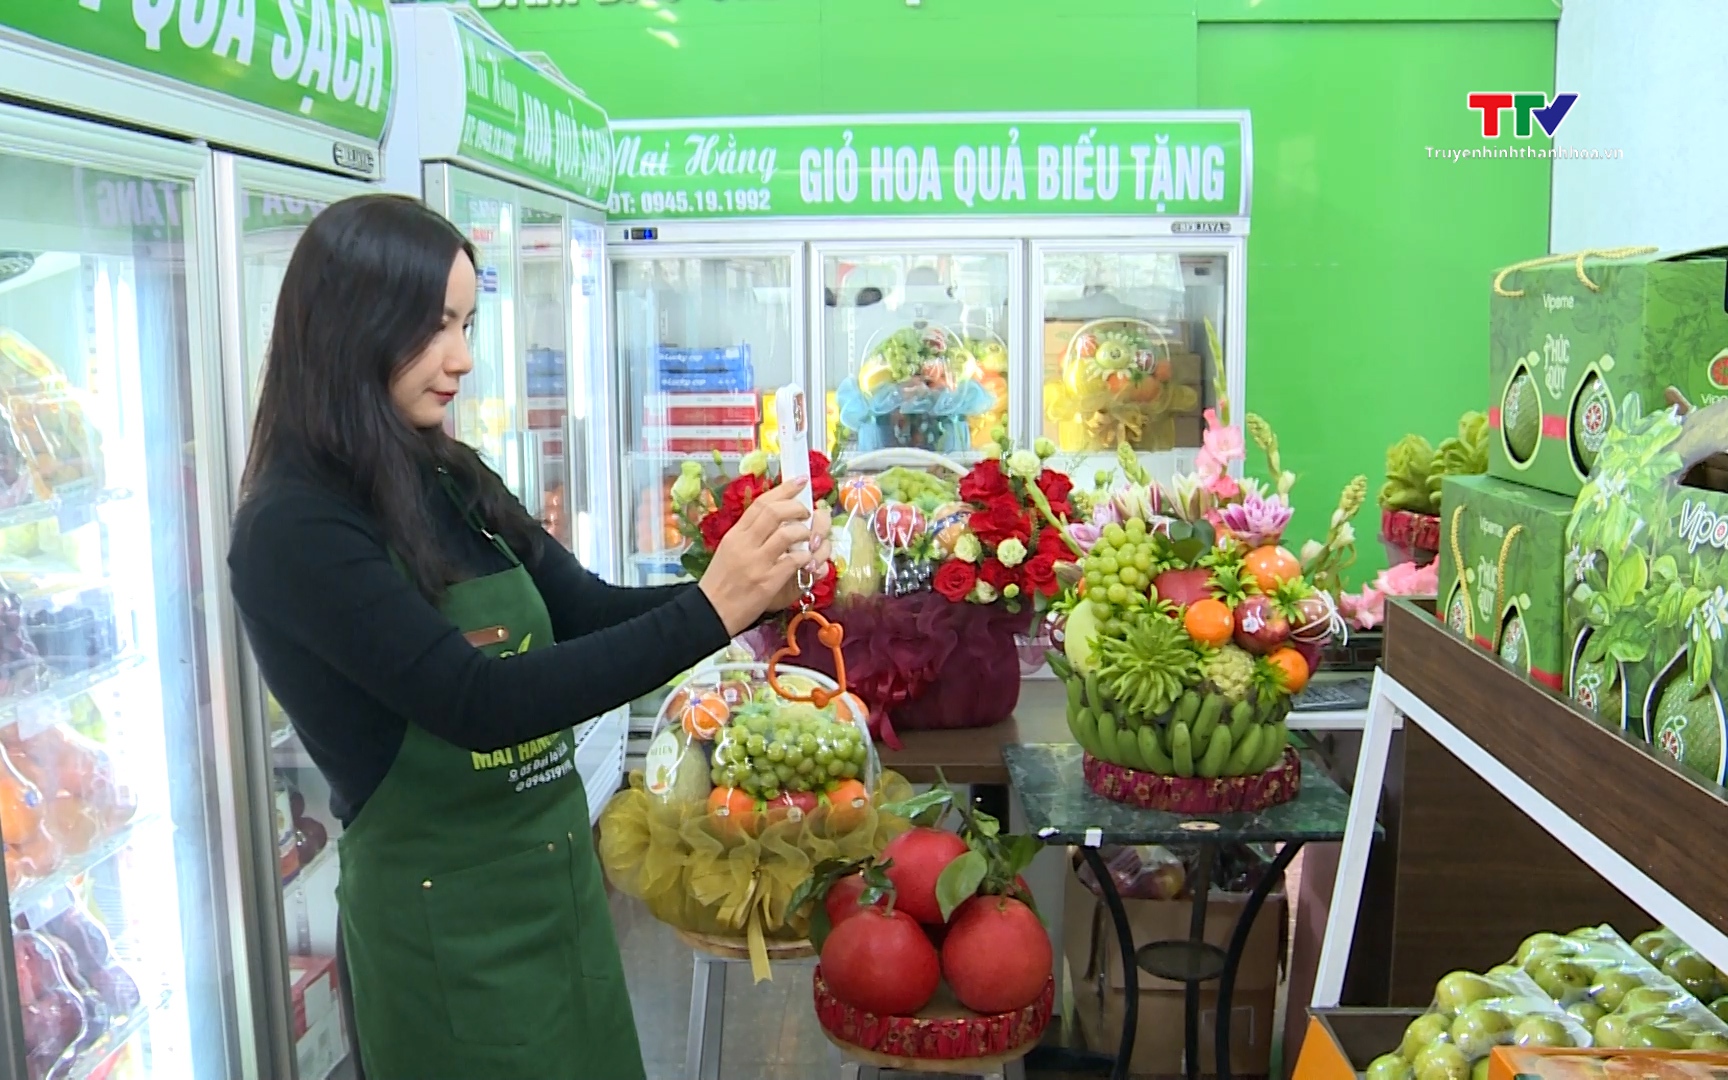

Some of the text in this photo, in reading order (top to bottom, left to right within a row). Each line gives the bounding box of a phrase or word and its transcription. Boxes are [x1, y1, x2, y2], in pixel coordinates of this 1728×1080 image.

[270, 0, 386, 115] SẠCH
[522, 91, 551, 168] HOA
[683, 131, 778, 184] Hằng
[640, 187, 772, 214] 0945.19.1992
[799, 126, 1226, 213] GIỎ HOA QUẢ BIẾU TẶNG
[471, 747, 514, 770] MAI
